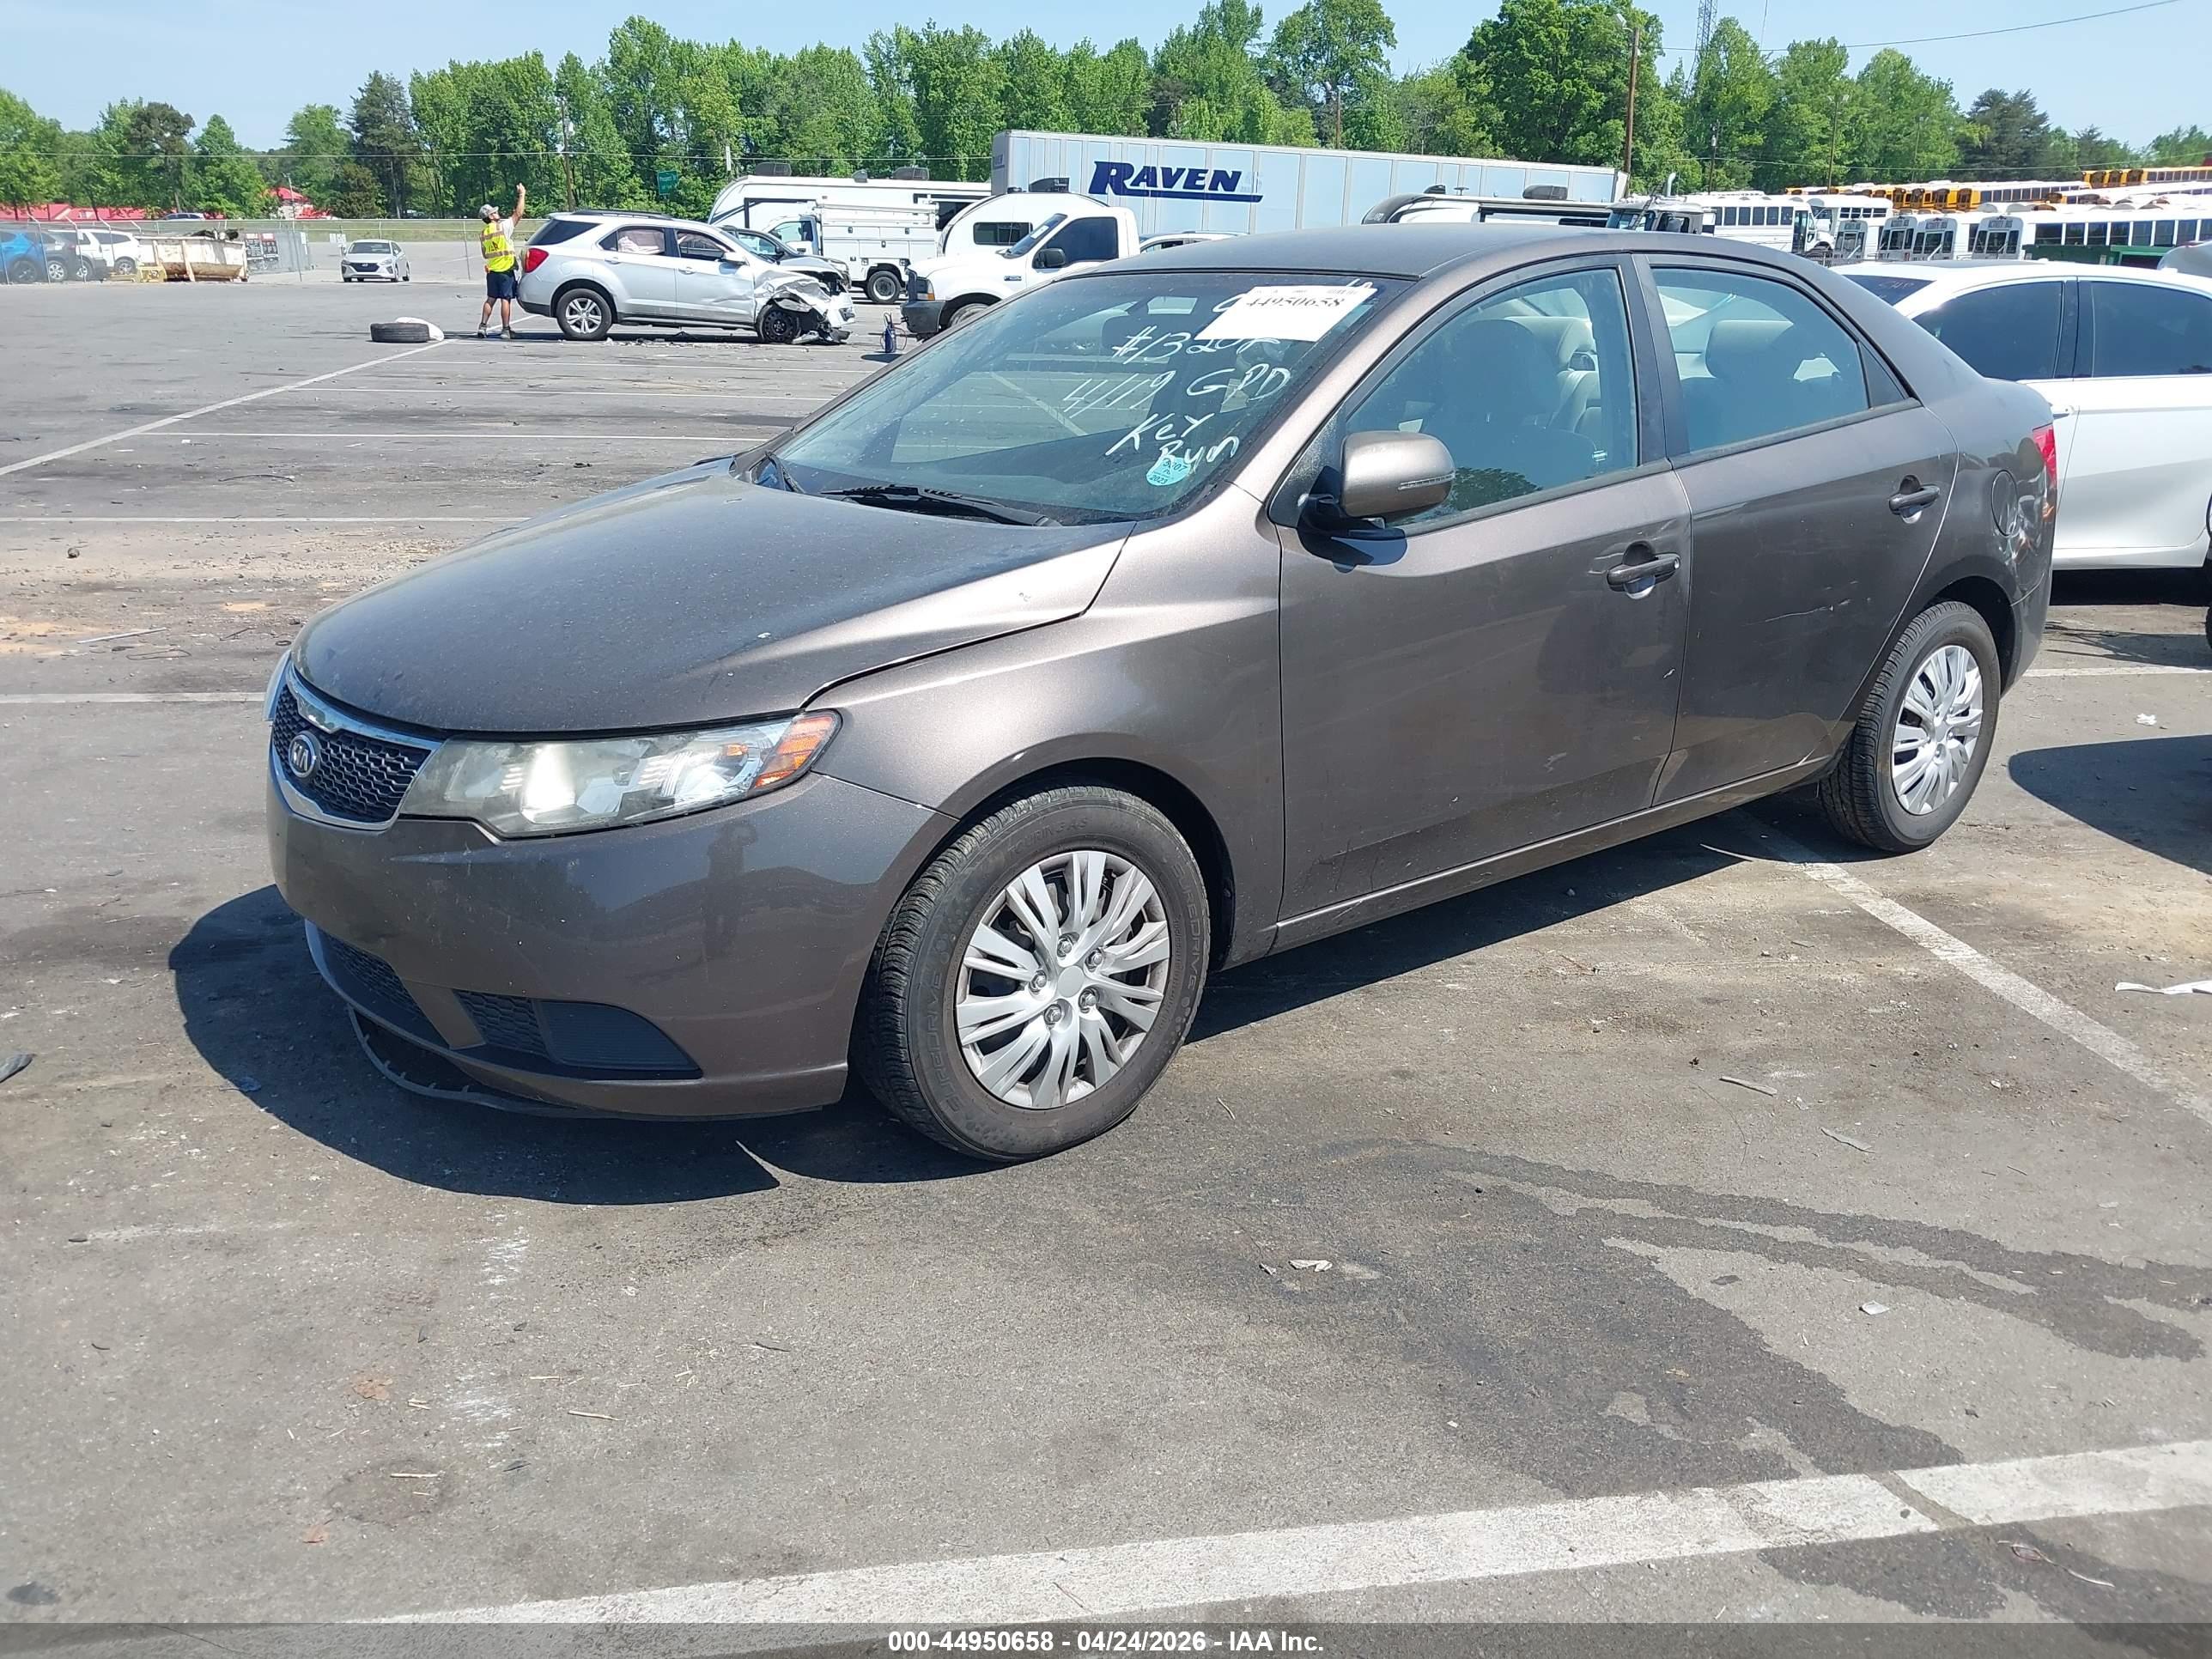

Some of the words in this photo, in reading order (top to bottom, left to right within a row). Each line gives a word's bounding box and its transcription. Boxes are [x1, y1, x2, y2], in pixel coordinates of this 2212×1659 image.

[1088, 161, 1244, 196] RAVEN
[1187, 363, 1291, 405] GPD
[292, 741, 309, 772] KIA
[1171, 863, 1201, 991] SUREDRIVE
